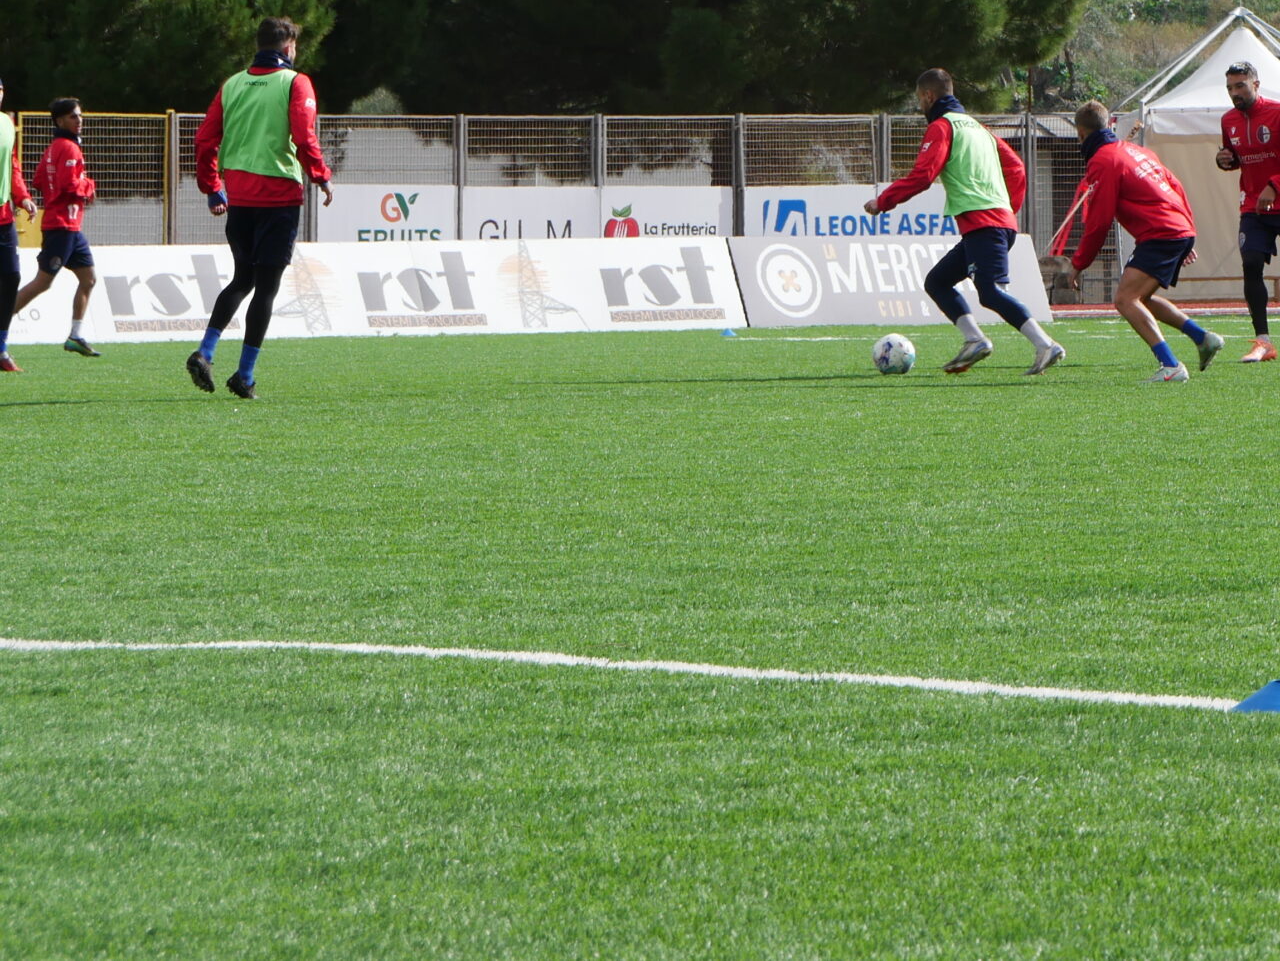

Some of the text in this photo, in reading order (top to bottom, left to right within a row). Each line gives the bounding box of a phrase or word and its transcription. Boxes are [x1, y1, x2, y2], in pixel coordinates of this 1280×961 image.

[67, 204, 79, 220] 17
[644, 222, 717, 235] La Frutteria
[815, 214, 890, 236] LEONE
[822, 244, 836, 260] LA
[600, 246, 715, 306] rst
[826, 242, 950, 293] MERCE
[103, 254, 229, 316] rst
[357, 251, 475, 312] rst
[611, 308, 726, 322] SISTEMI TECNOLOGICI
[878, 300, 931, 317] CIBI &
[368, 313, 488, 327] SISTEMI TECNOLOGICI
